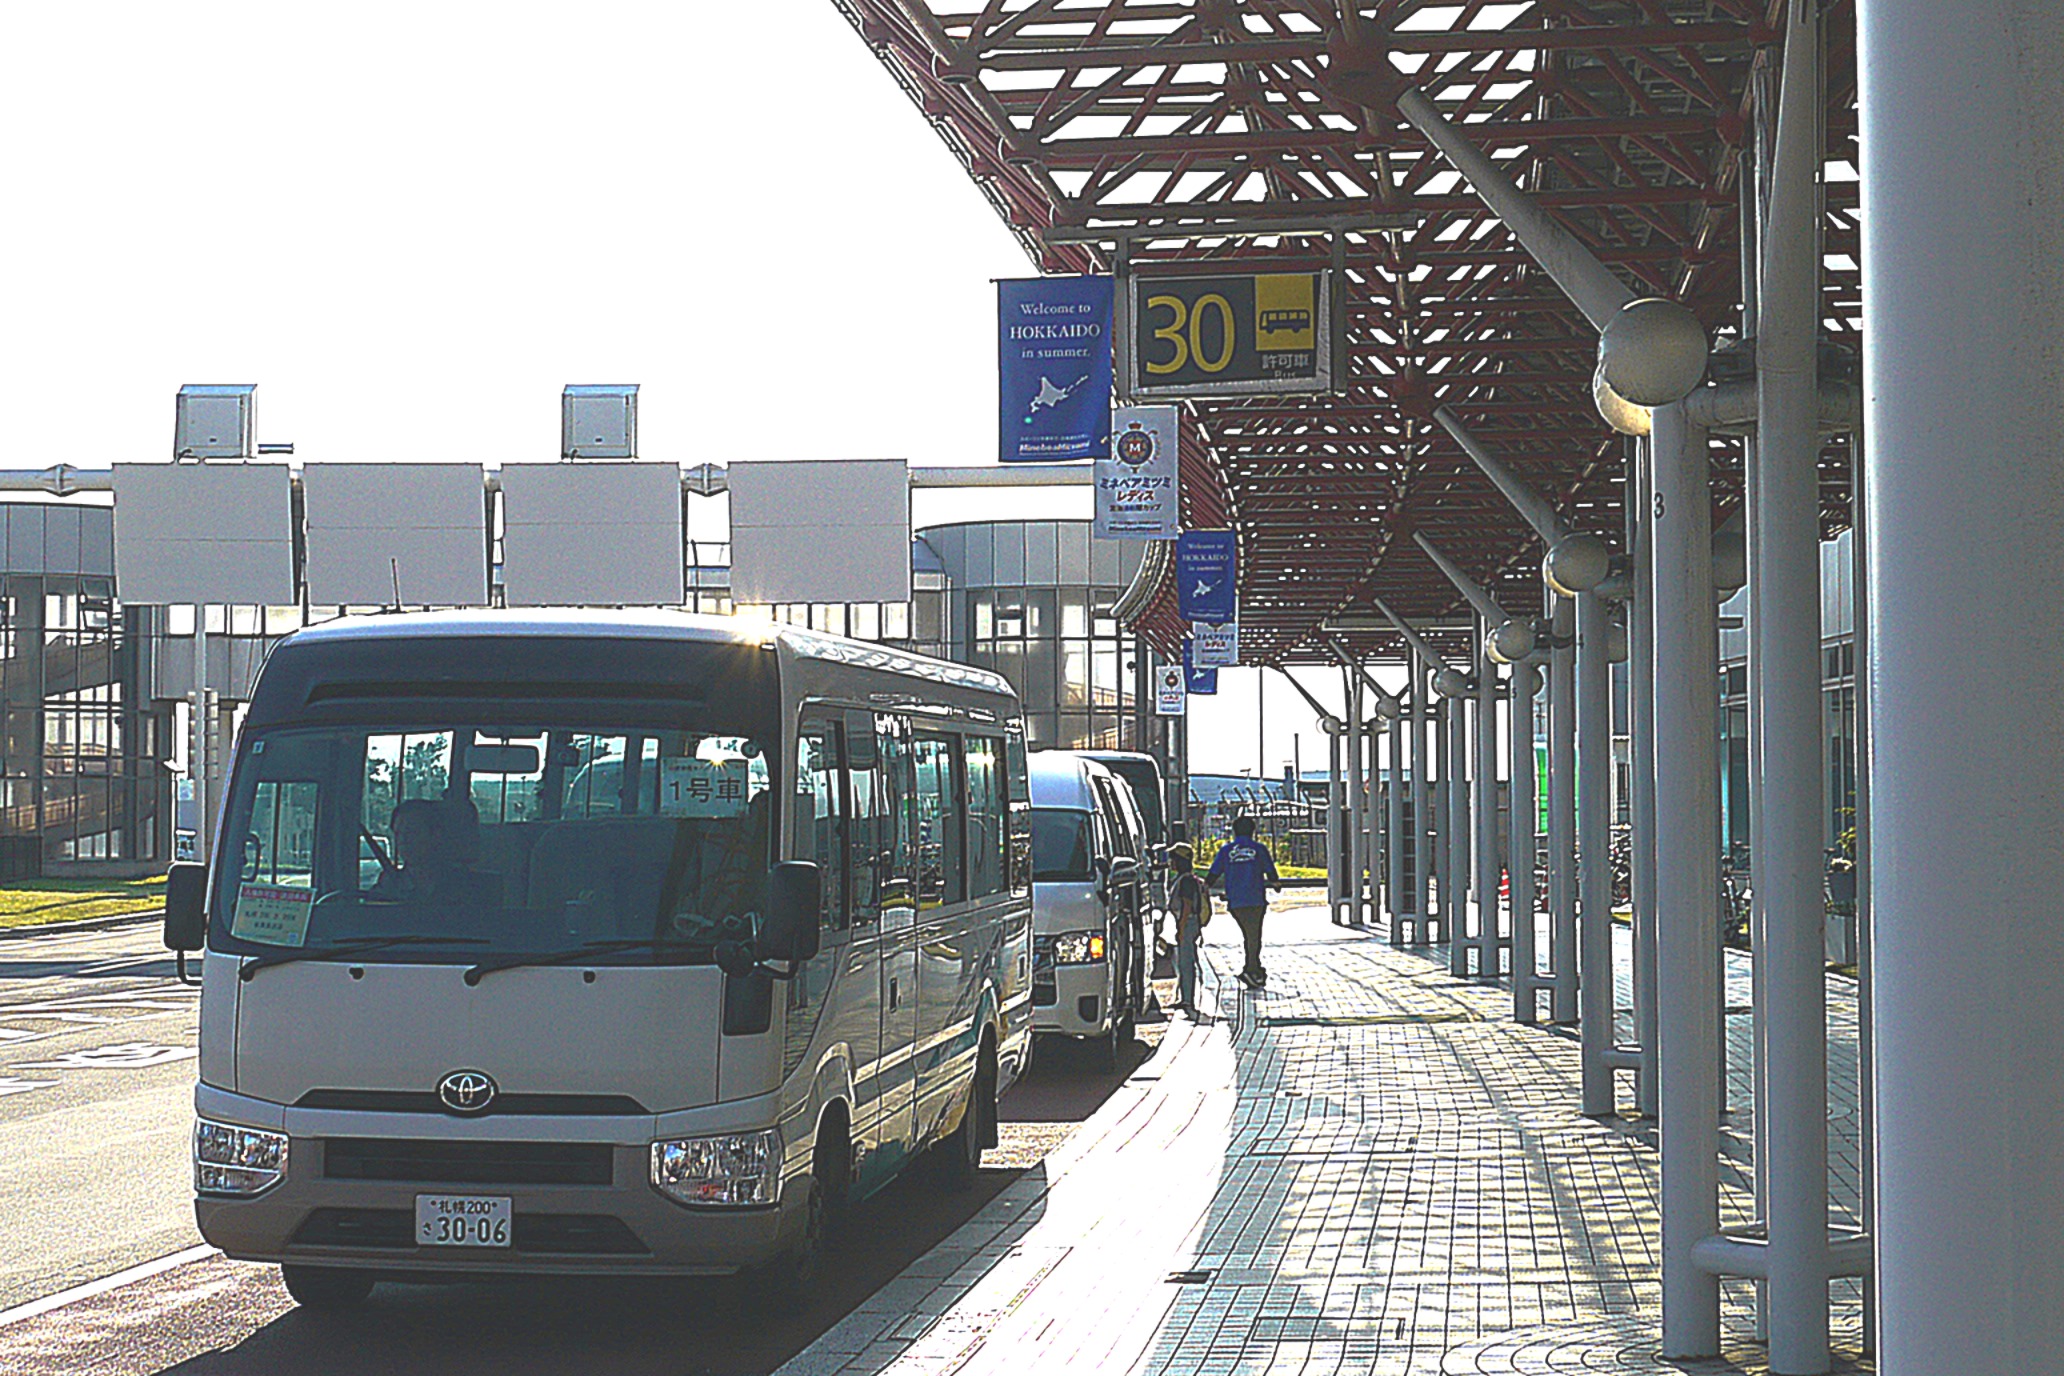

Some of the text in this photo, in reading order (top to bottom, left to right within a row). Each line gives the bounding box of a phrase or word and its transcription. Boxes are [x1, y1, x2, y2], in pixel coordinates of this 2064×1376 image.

[1020, 302, 1091, 315] Welcome to
[1010, 323, 1100, 339] HOKKAIDO
[1146, 293, 1235, 374] 30
[1021, 347, 1034, 358] in
[1100, 476, 1171, 490] ミネベアミツミ
[1116, 490, 1154, 502] レディス
[669, 776, 743, 804] 1号車
[436, 1216, 507, 1243] 30-06
